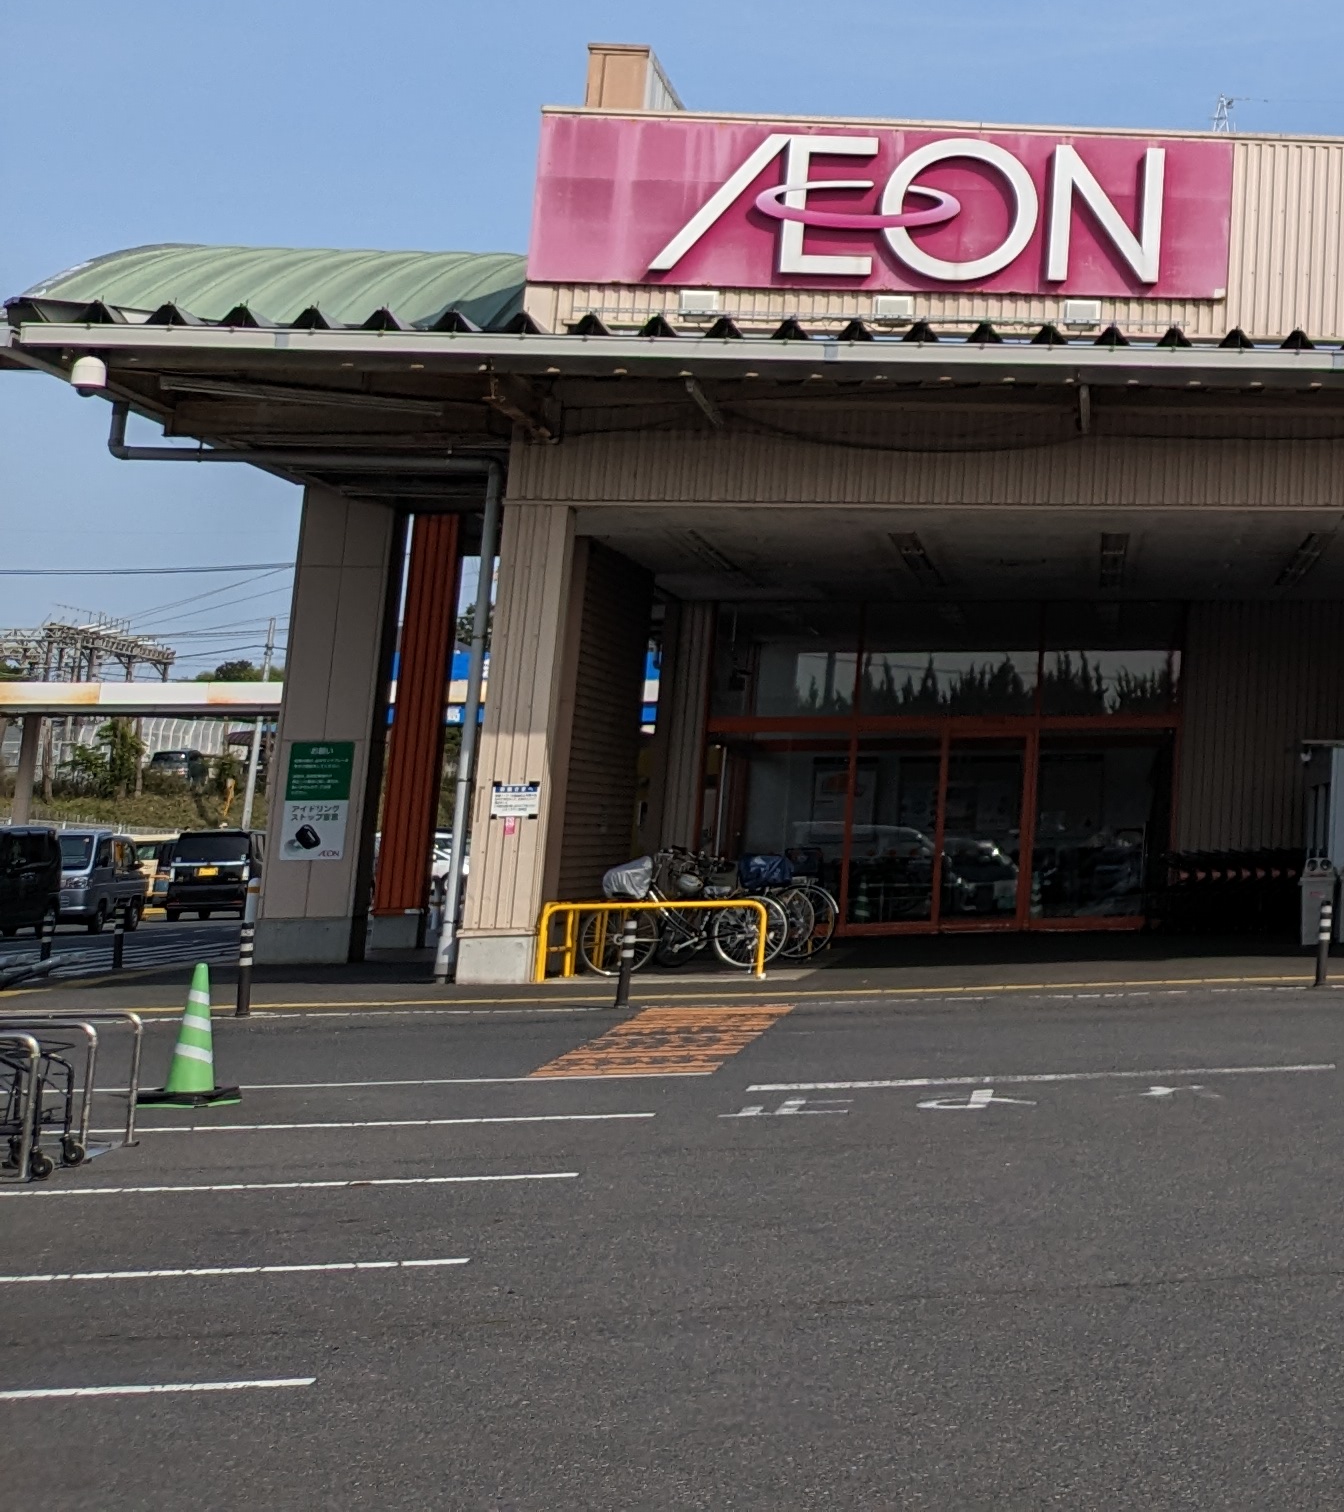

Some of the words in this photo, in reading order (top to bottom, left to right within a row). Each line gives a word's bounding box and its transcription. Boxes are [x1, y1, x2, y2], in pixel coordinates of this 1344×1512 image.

[291, 805, 340, 813] アイドリング
